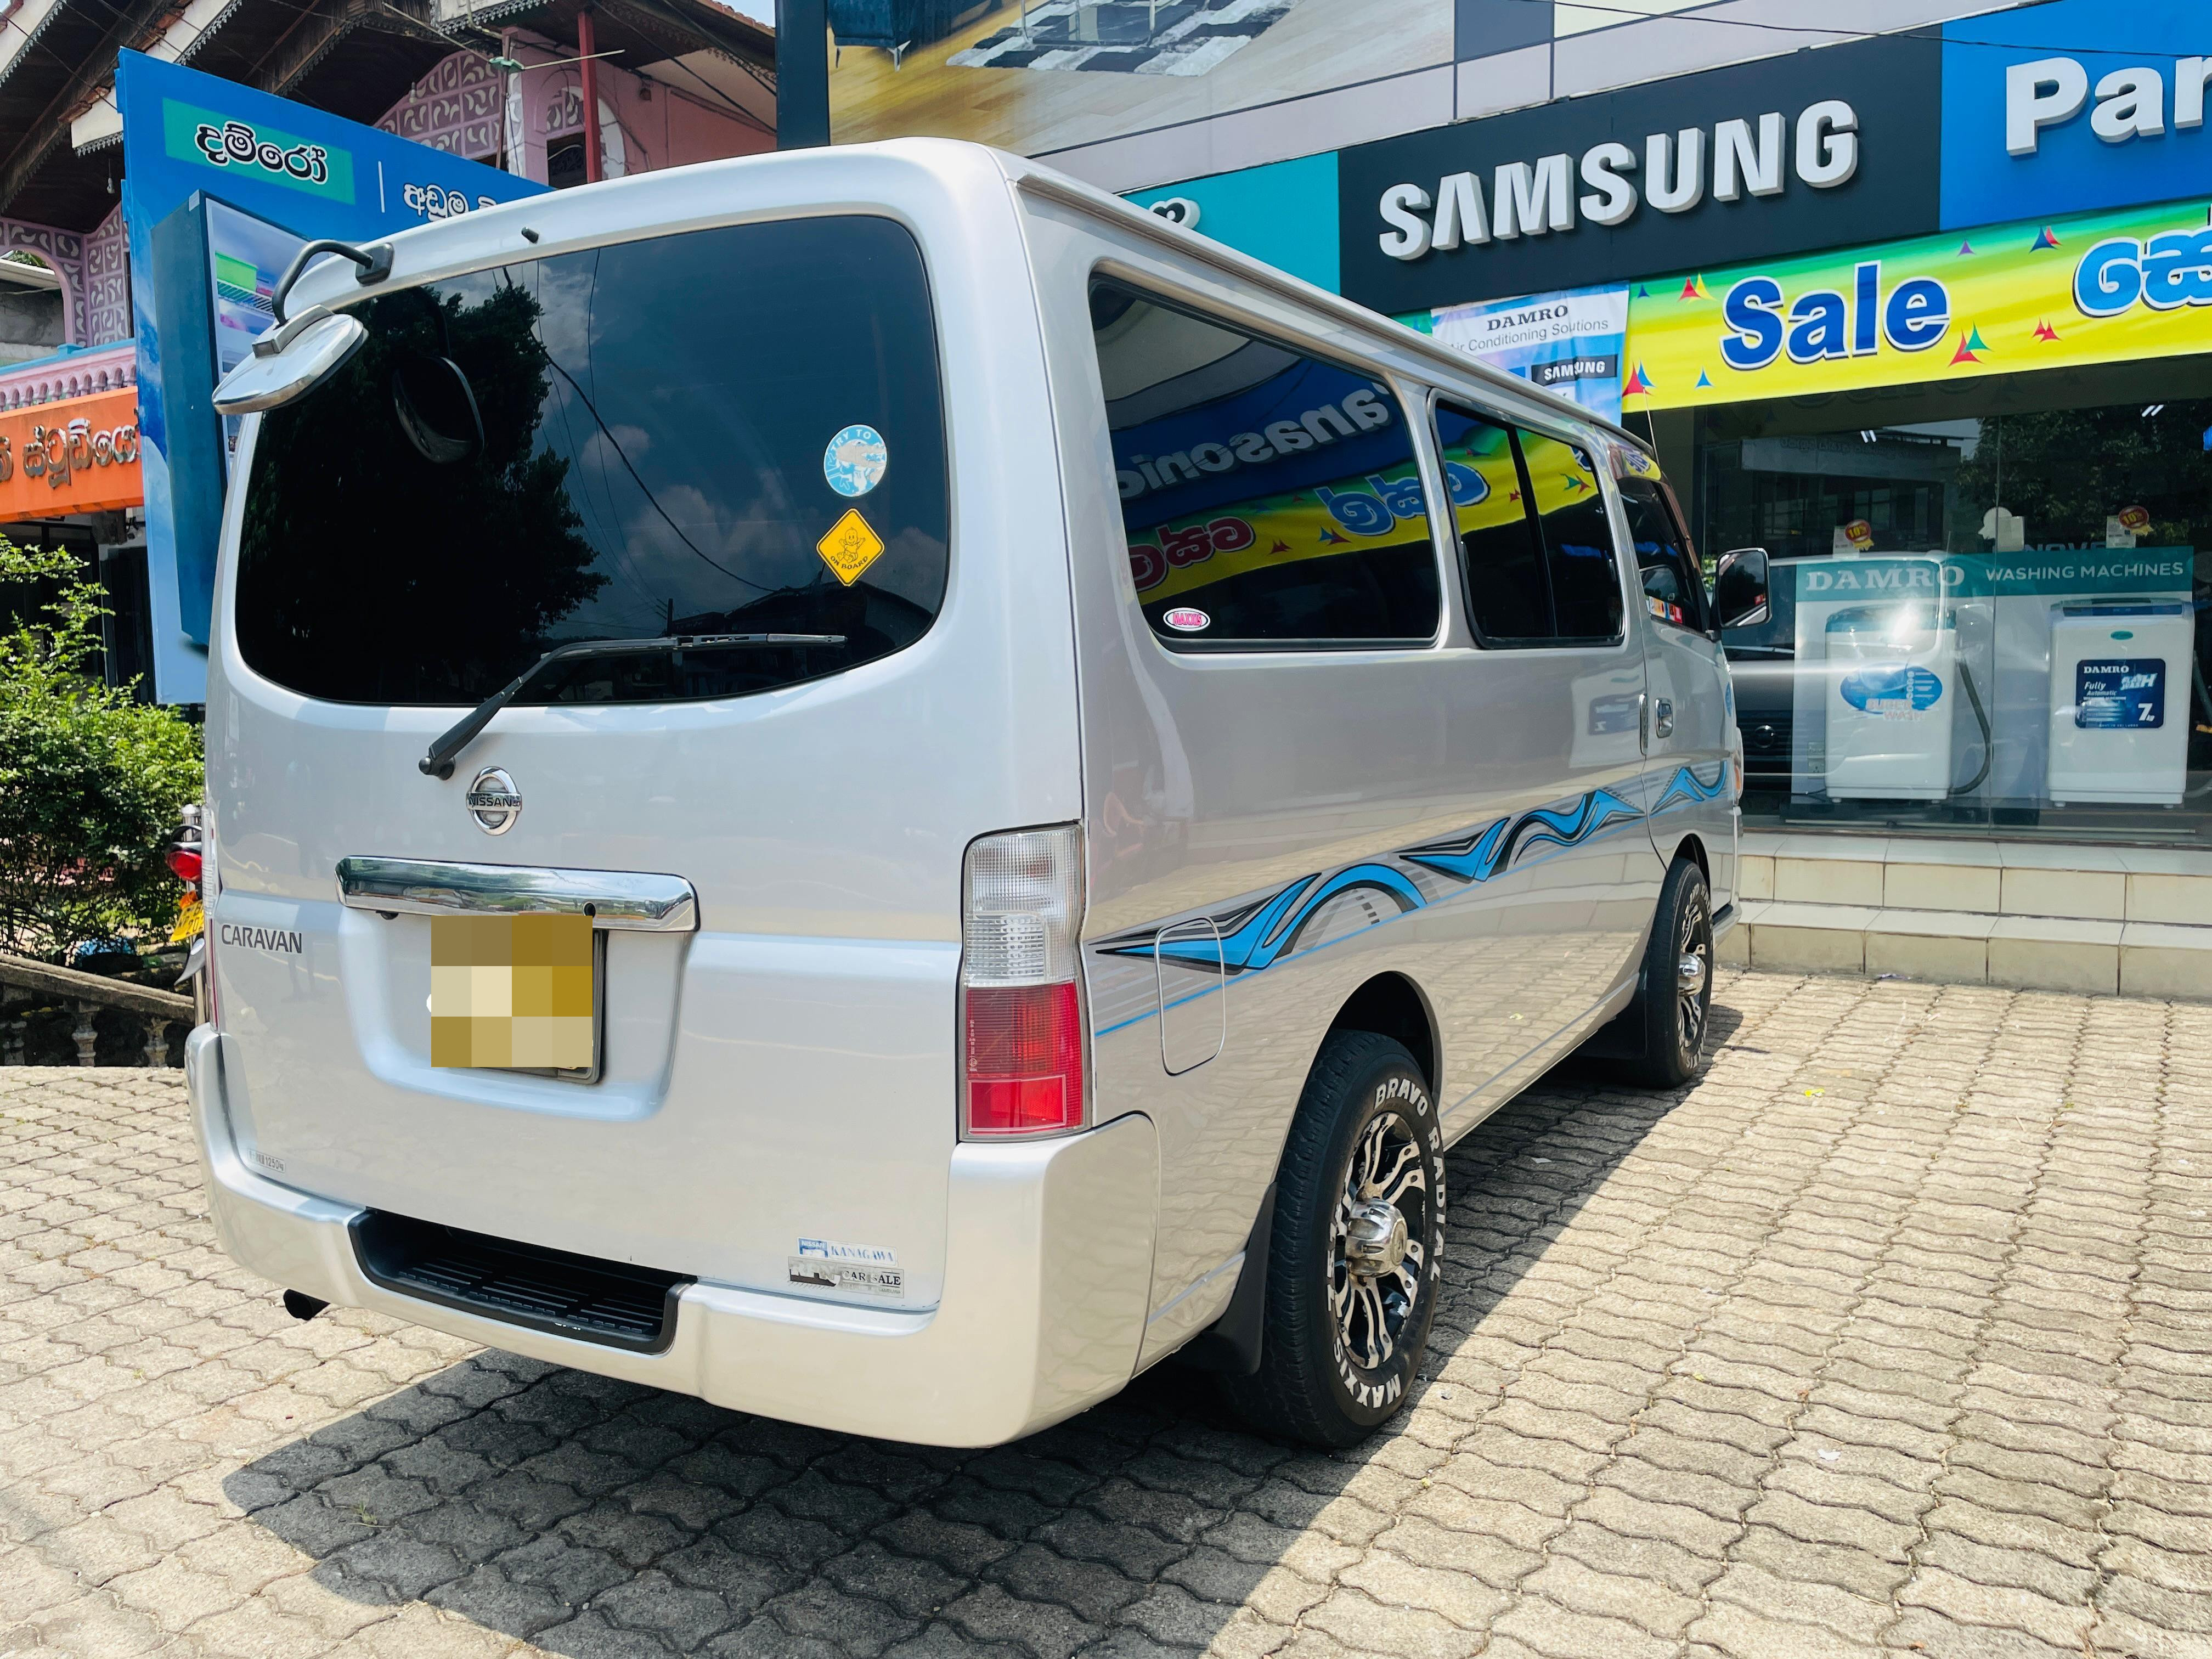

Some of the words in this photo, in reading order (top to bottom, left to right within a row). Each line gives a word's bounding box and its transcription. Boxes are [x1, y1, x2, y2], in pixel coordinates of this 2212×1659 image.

[195, 121, 328, 185] දම්රෝ
[1379, 99, 1858, 261] SAMSUNG
[1487, 305, 1568, 331] DAMRO
[1720, 260, 1950, 371] Sale
[1469, 328, 1547, 352] Conditioning
[1544, 361, 1606, 381] SAMSUNG
[830, 431, 850, 452] TRY
[855, 429, 871, 439] TO
[830, 555, 839, 566] ON
[841, 555, 868, 570] BOARD
[1806, 565, 1965, 591] DAMRO
[1985, 566, 2075, 582] WASHING
[2080, 562, 2184, 578] MACHINES
[1173, 612, 1202, 625] MAXXIS
[2084, 665, 2130, 674] DAMRO
[2084, 681, 2106, 690] Fully
[469, 796, 512, 807] NISSAN
[221, 923, 302, 954] CARAVAN
[1375, 1077, 1429, 1117] BRAVO
[1427, 1126, 1444, 1282] RADIAL
[800, 1239, 825, 1248] NISSAN
[831, 1245, 894, 1262] KANAGAWA
[842, 1270, 866, 1282] CAR
[1334, 1336, 1401, 1408] MAXXIS
